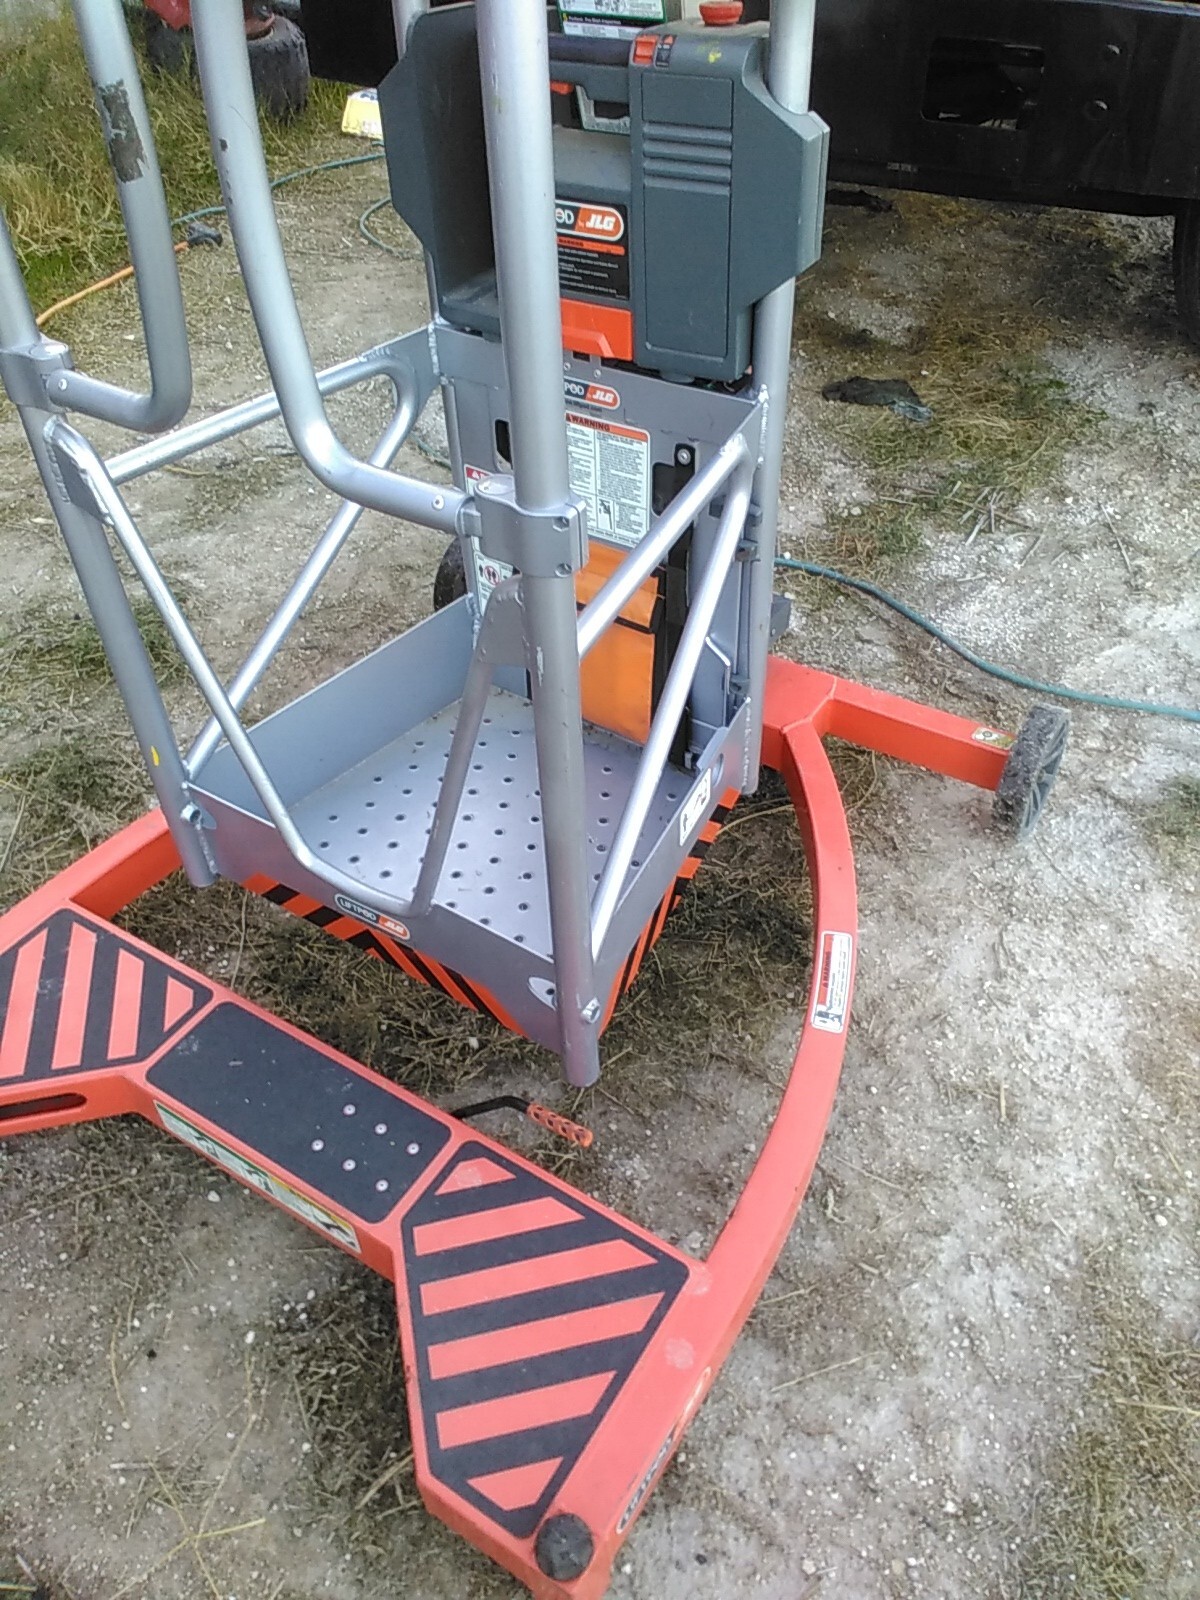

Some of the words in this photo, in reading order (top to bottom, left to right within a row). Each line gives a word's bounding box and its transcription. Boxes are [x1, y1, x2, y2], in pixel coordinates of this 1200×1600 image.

[585, 213, 616, 232] JLG
[592, 390, 615, 403] JLG
[570, 413, 611, 432] WARNING
[339, 898, 377, 921] LIFTPOD
